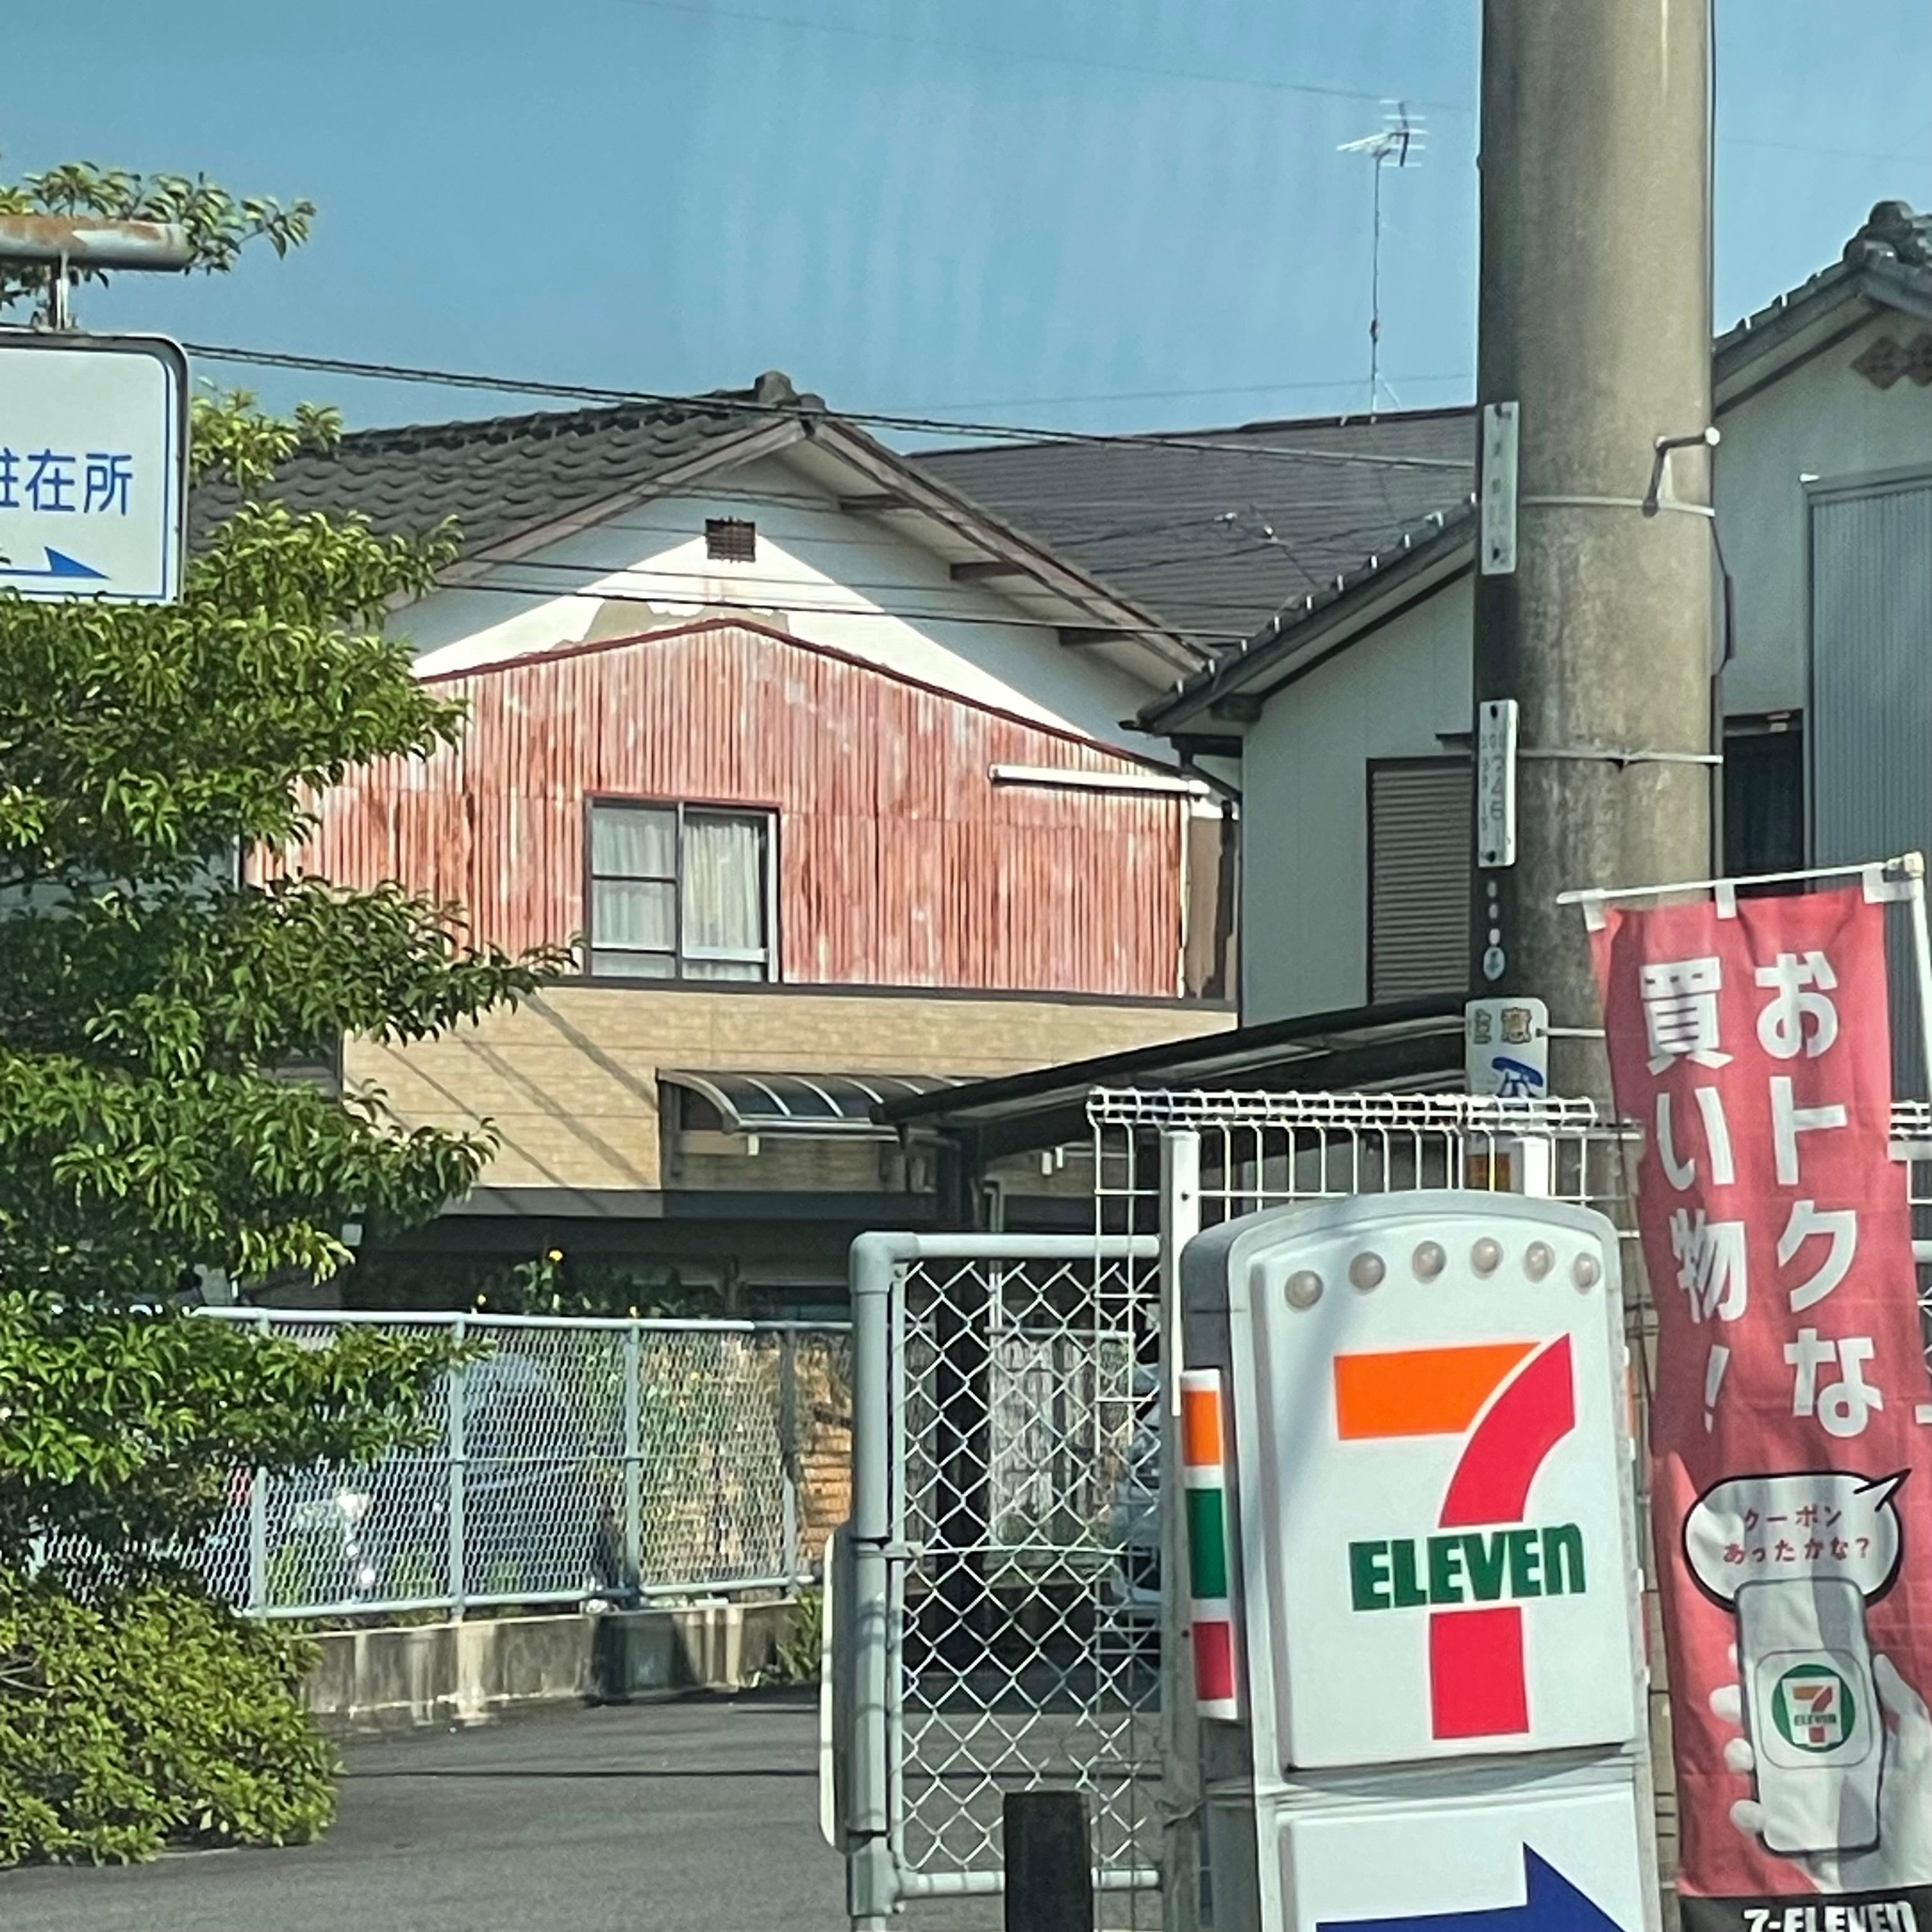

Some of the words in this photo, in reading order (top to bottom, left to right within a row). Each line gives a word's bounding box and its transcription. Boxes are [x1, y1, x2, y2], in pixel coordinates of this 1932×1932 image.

[1638, 956, 1748, 1434] 買い物！
[1754, 950, 1883, 1438] おトクな
[1333, 1333, 1575, 1740] 7
[1723, 1536, 1869, 1564] あったかな？
[1745, 1505, 1841, 1531] クーポン
